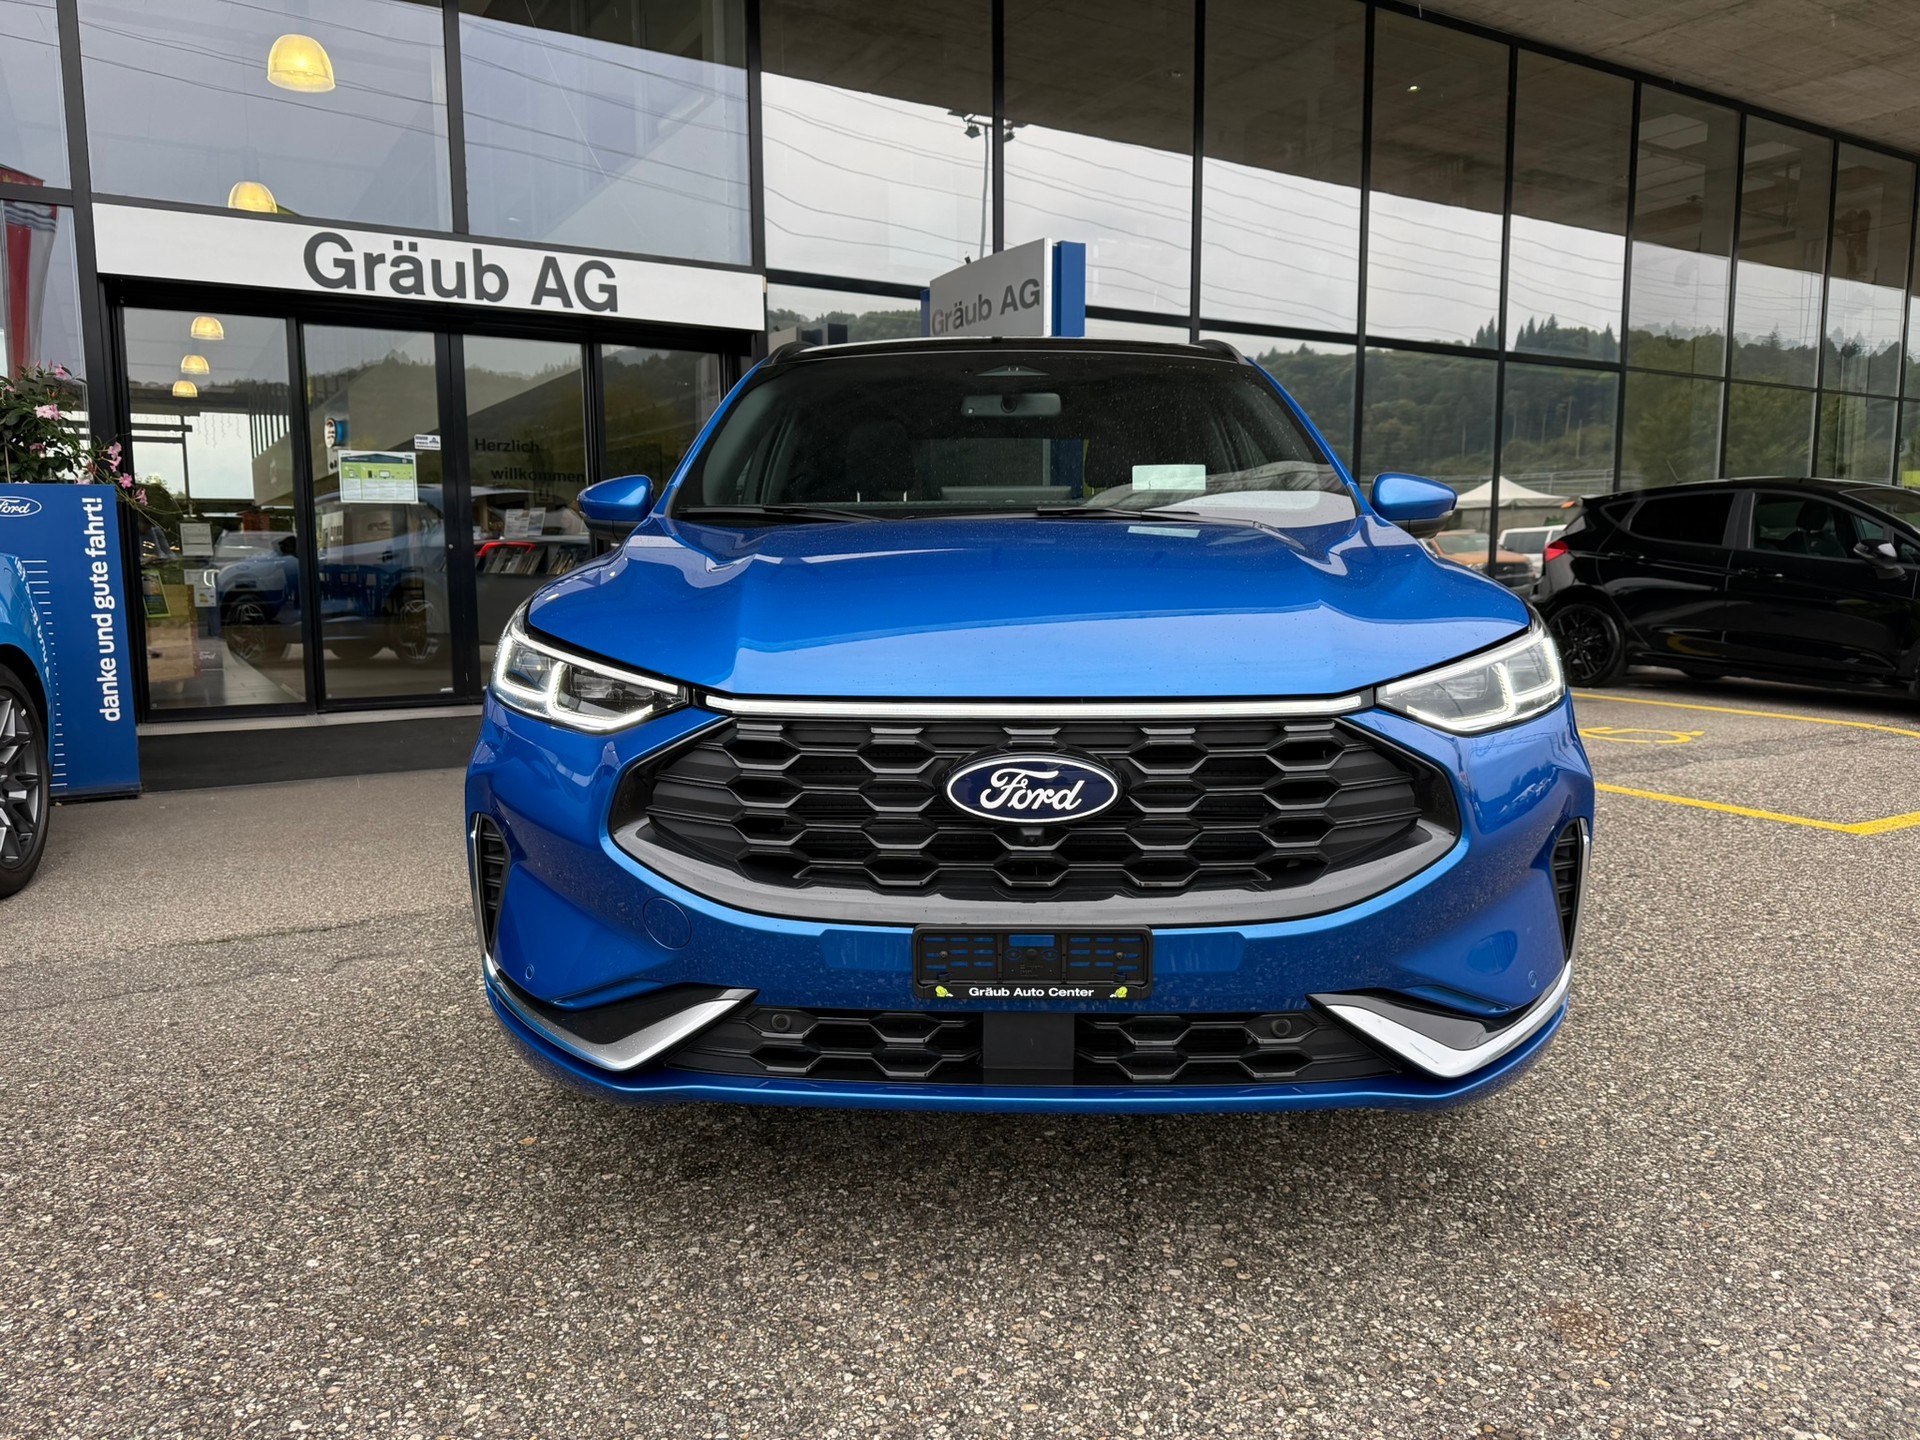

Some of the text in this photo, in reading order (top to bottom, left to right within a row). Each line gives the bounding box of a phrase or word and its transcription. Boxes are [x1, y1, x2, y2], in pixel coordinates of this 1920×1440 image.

[303, 231, 619, 313] Gräub AG
[931, 278, 1040, 337] Gräub AG
[474, 438, 541, 454] Herzlich
[490, 466, 586, 483] willkommen
[81, 497, 121, 723] danke und gute fahrt!
[979, 767, 1085, 811] Ford
[968, 986, 1095, 997] Gräub Auto Center
